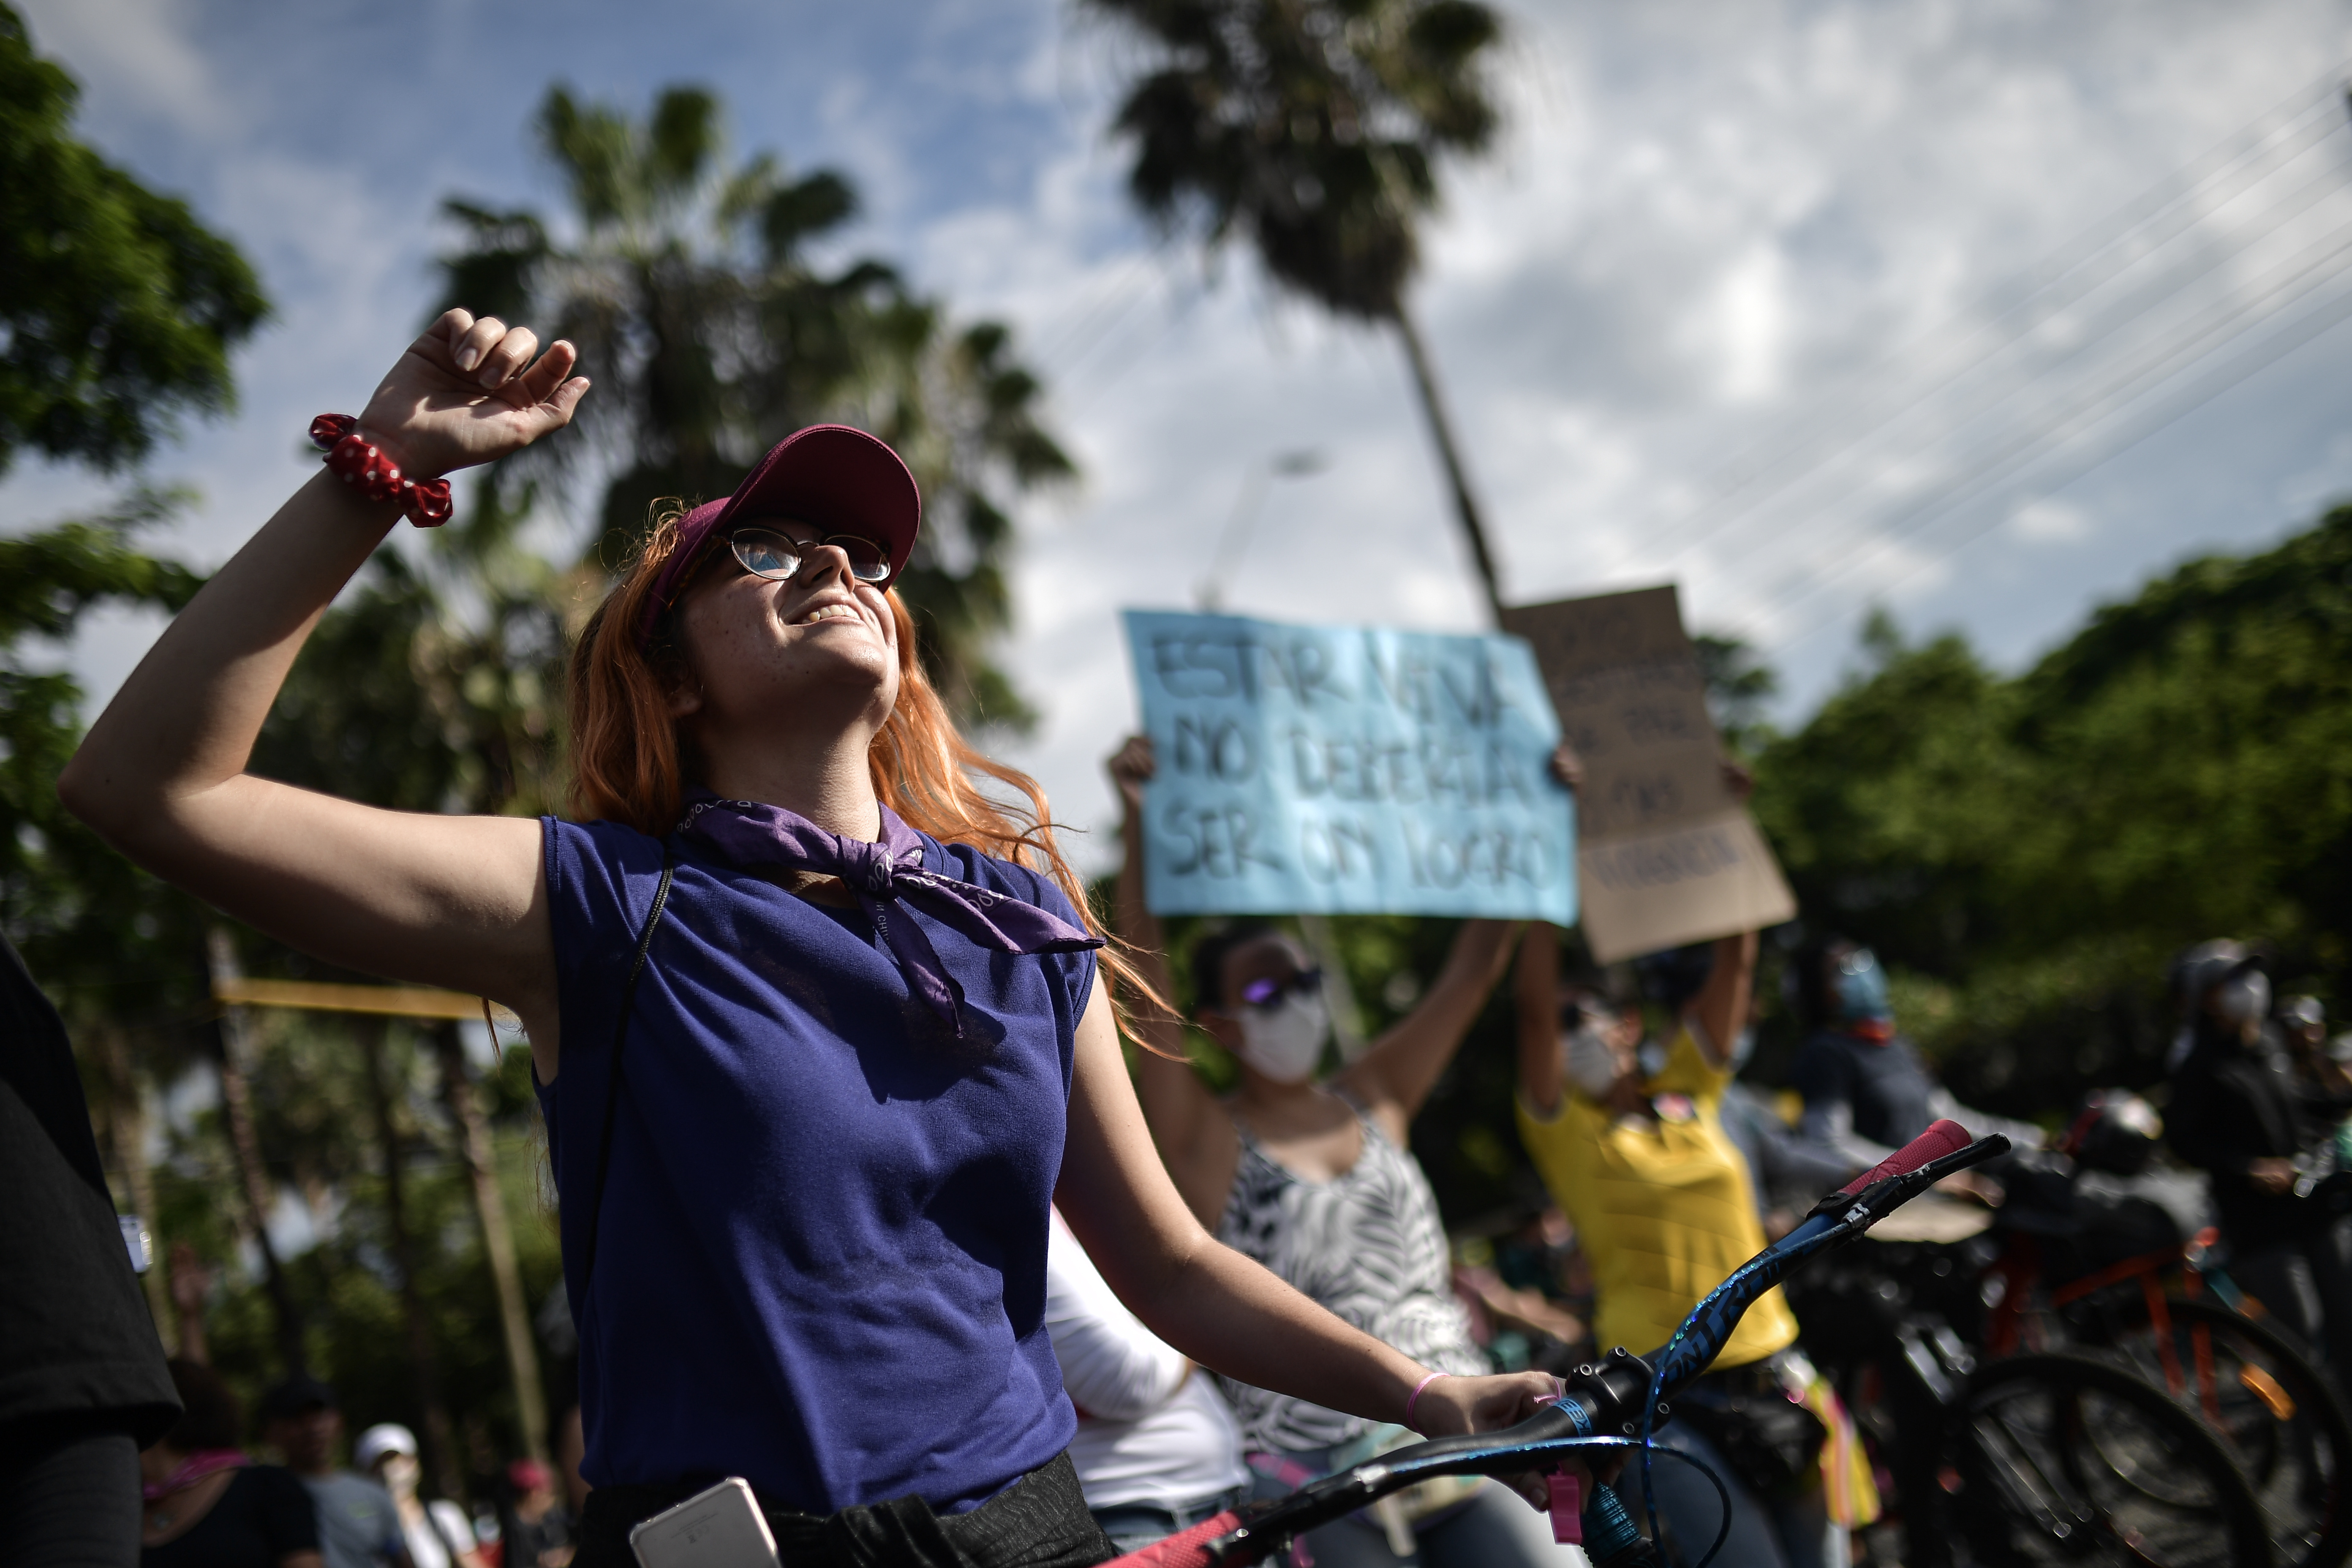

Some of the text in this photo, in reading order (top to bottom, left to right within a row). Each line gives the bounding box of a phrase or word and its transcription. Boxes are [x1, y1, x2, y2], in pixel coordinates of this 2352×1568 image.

[1146, 629, 1354, 708] ESTAR
[1172, 712, 1259, 783] NO
[1164, 798, 1288, 879] SER
